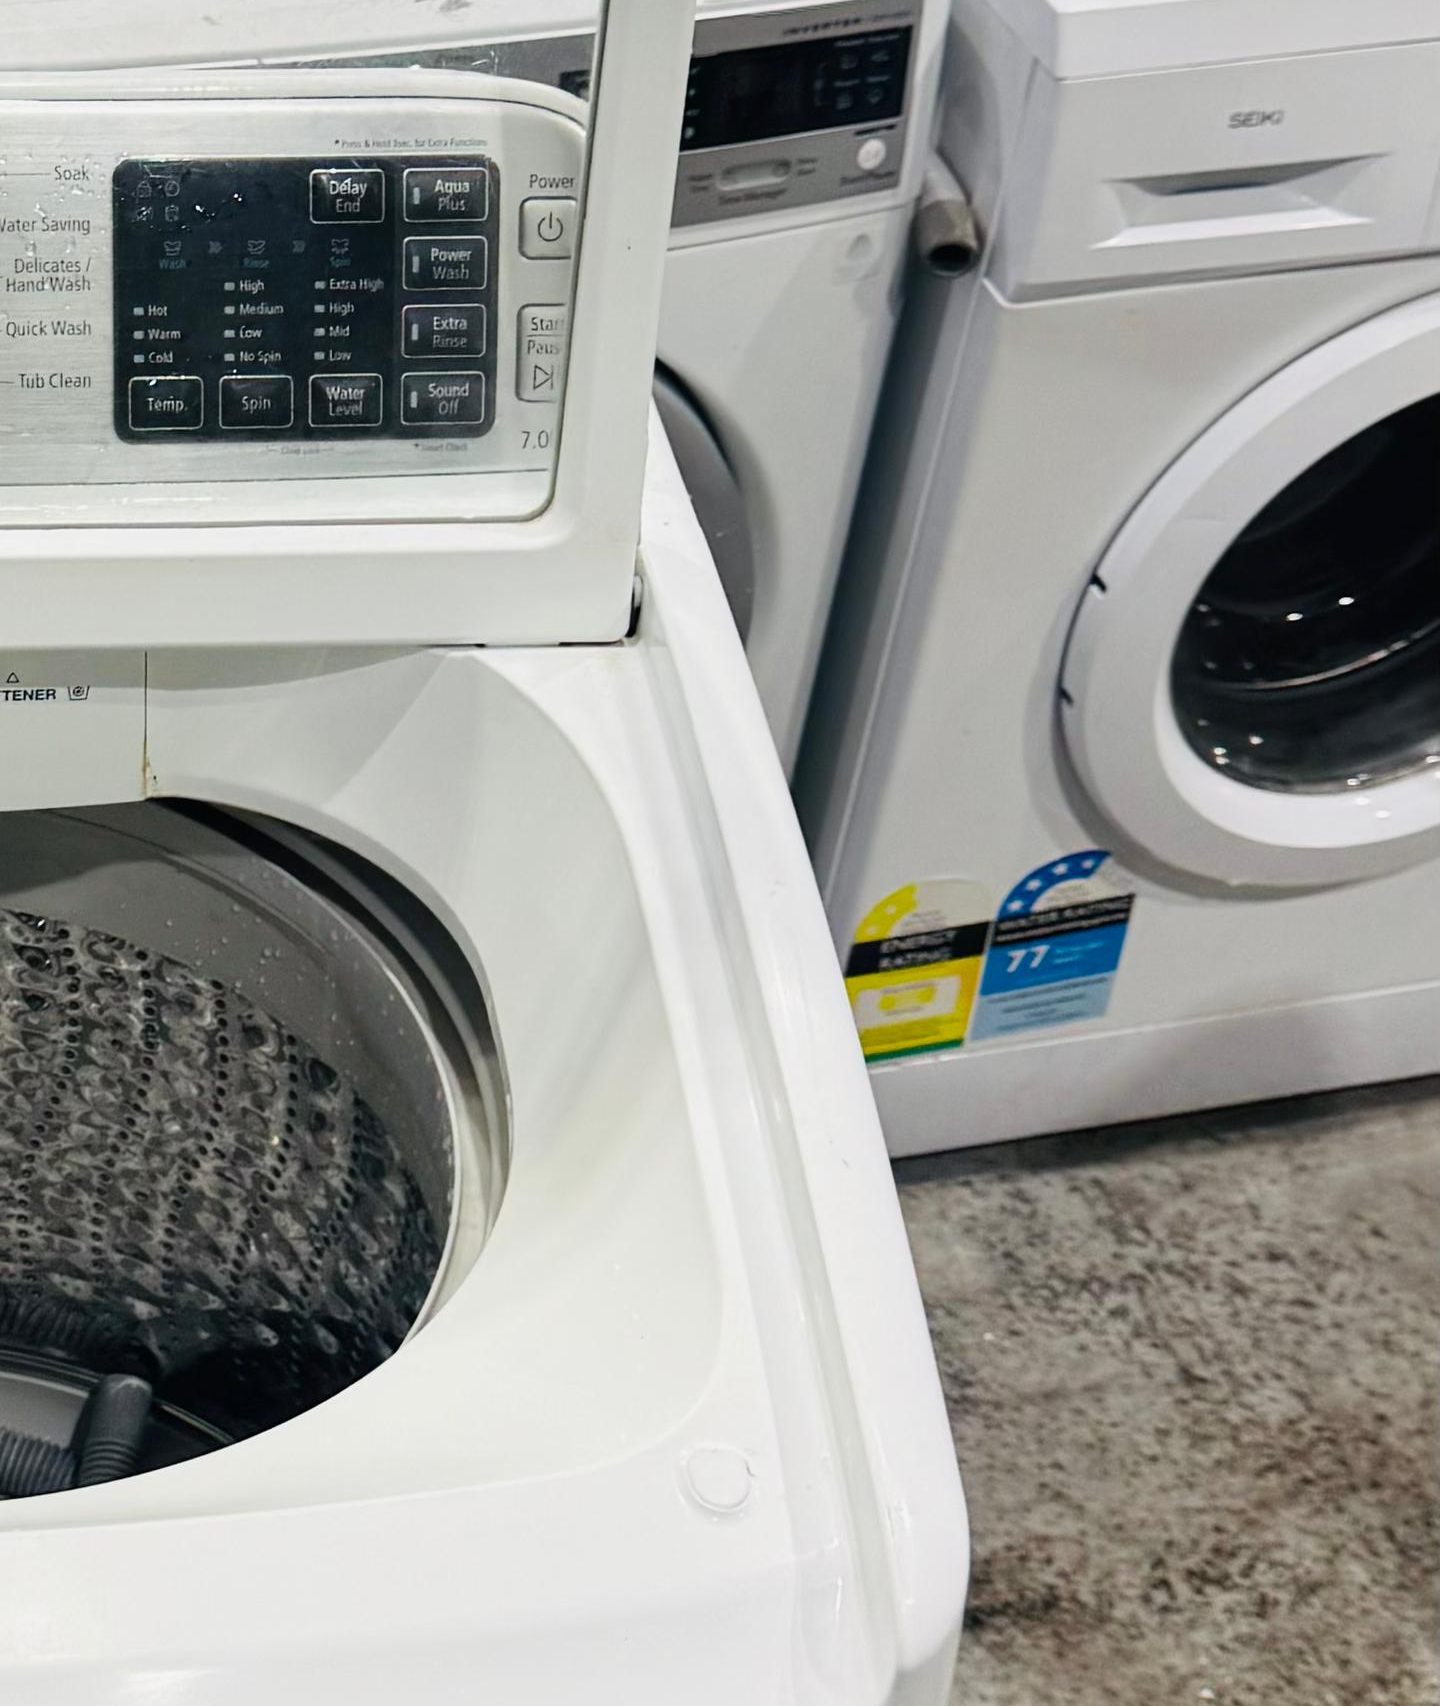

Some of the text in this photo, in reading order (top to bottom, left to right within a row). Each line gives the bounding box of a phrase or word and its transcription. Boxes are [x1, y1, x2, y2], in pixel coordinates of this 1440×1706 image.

[54, 165, 91, 182] Soak
[329, 178, 368, 197] Delay
[434, 179, 471, 196] Aqua
[529, 174, 576, 190] Power
[335, 198, 361, 214] End
[438, 196, 466, 212] Plus
[42, 216, 91, 237] Saving
[430, 247, 472, 263] Power
[13, 256, 80, 275] Delicates
[432, 264, 470, 281] Wash
[5, 275, 92, 293] Hand Wash
[239, 279, 265, 294] High
[329, 278, 385, 293] Extra High
[148, 305, 168, 317] Hot
[239, 302, 285, 316] Medium
[329, 302, 355, 317] High
[5, 319, 92, 338] Quick Wash
[329, 325, 350, 338] Mid
[432, 316, 468, 331] Extra
[148, 328, 182, 340] Warm
[239, 326, 263, 339] Low
[432, 334, 468, 349] Rinse
[148, 351, 174, 364] Cold
[240, 349, 282, 365] No Spin
[329, 349, 352, 362] Low
[18, 372, 92, 389] Tub Clean
[326, 386, 366, 402] Water
[428, 383, 470, 398] Sound
[146, 396, 189, 414] Temp.
[241, 395, 272, 414] Spin
[328, 401, 364, 416] Level
[438, 399, 460, 415] Off
[520, 429, 550, 450] 7.0
[1007, 944, 1051, 973] 77
